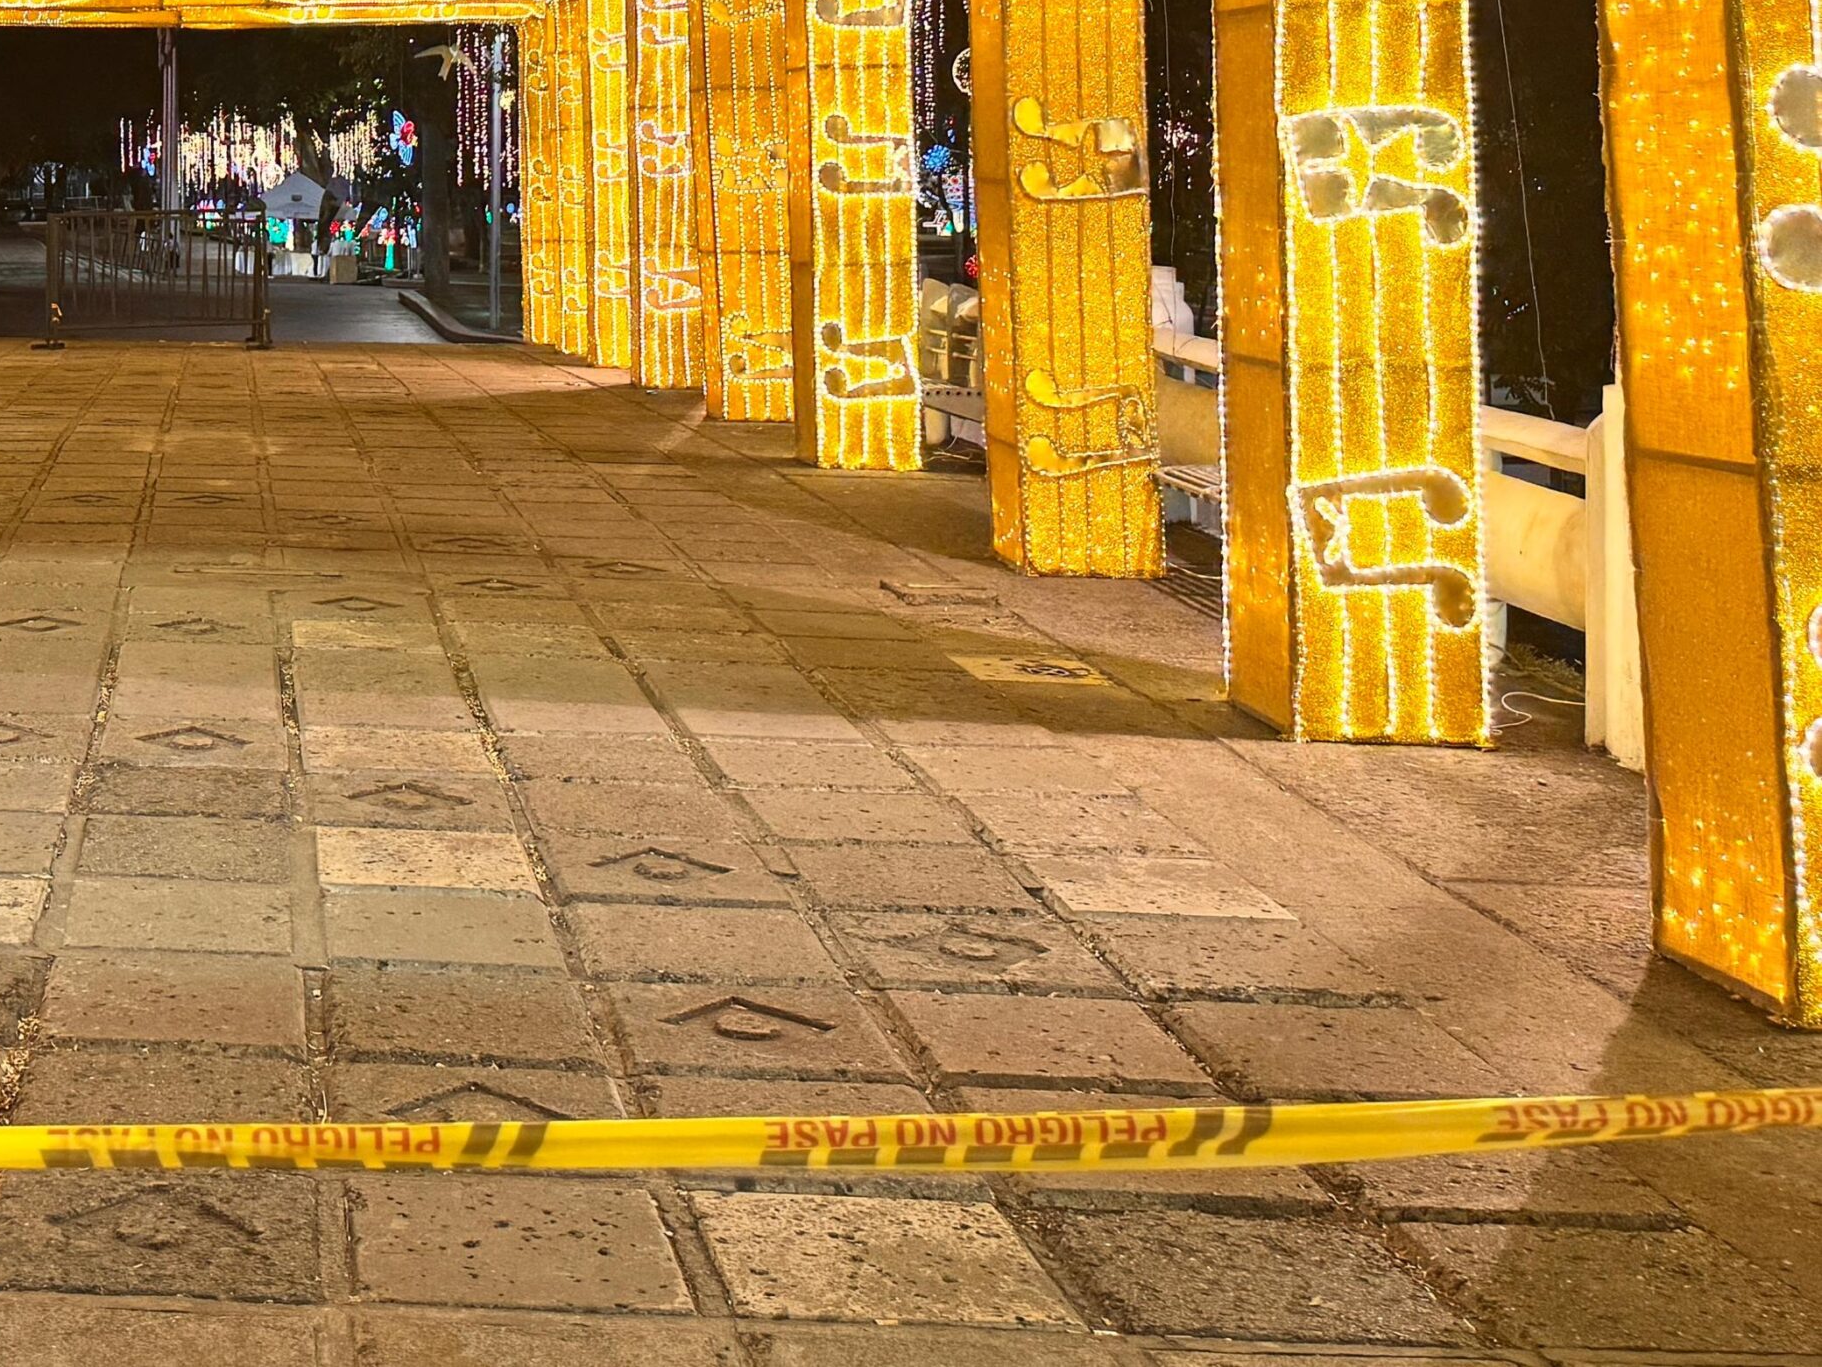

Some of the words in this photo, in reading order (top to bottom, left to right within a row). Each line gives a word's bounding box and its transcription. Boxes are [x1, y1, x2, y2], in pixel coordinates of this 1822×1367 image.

[1493, 1101, 1609, 1131] PASE
[1626, 1100, 1688, 1128] NO
[252, 1127, 441, 1154] PELIGRO
[764, 1119, 878, 1150] PASE
[895, 1118, 957, 1147] NO
[975, 1114, 1168, 1146] PELIGRO
